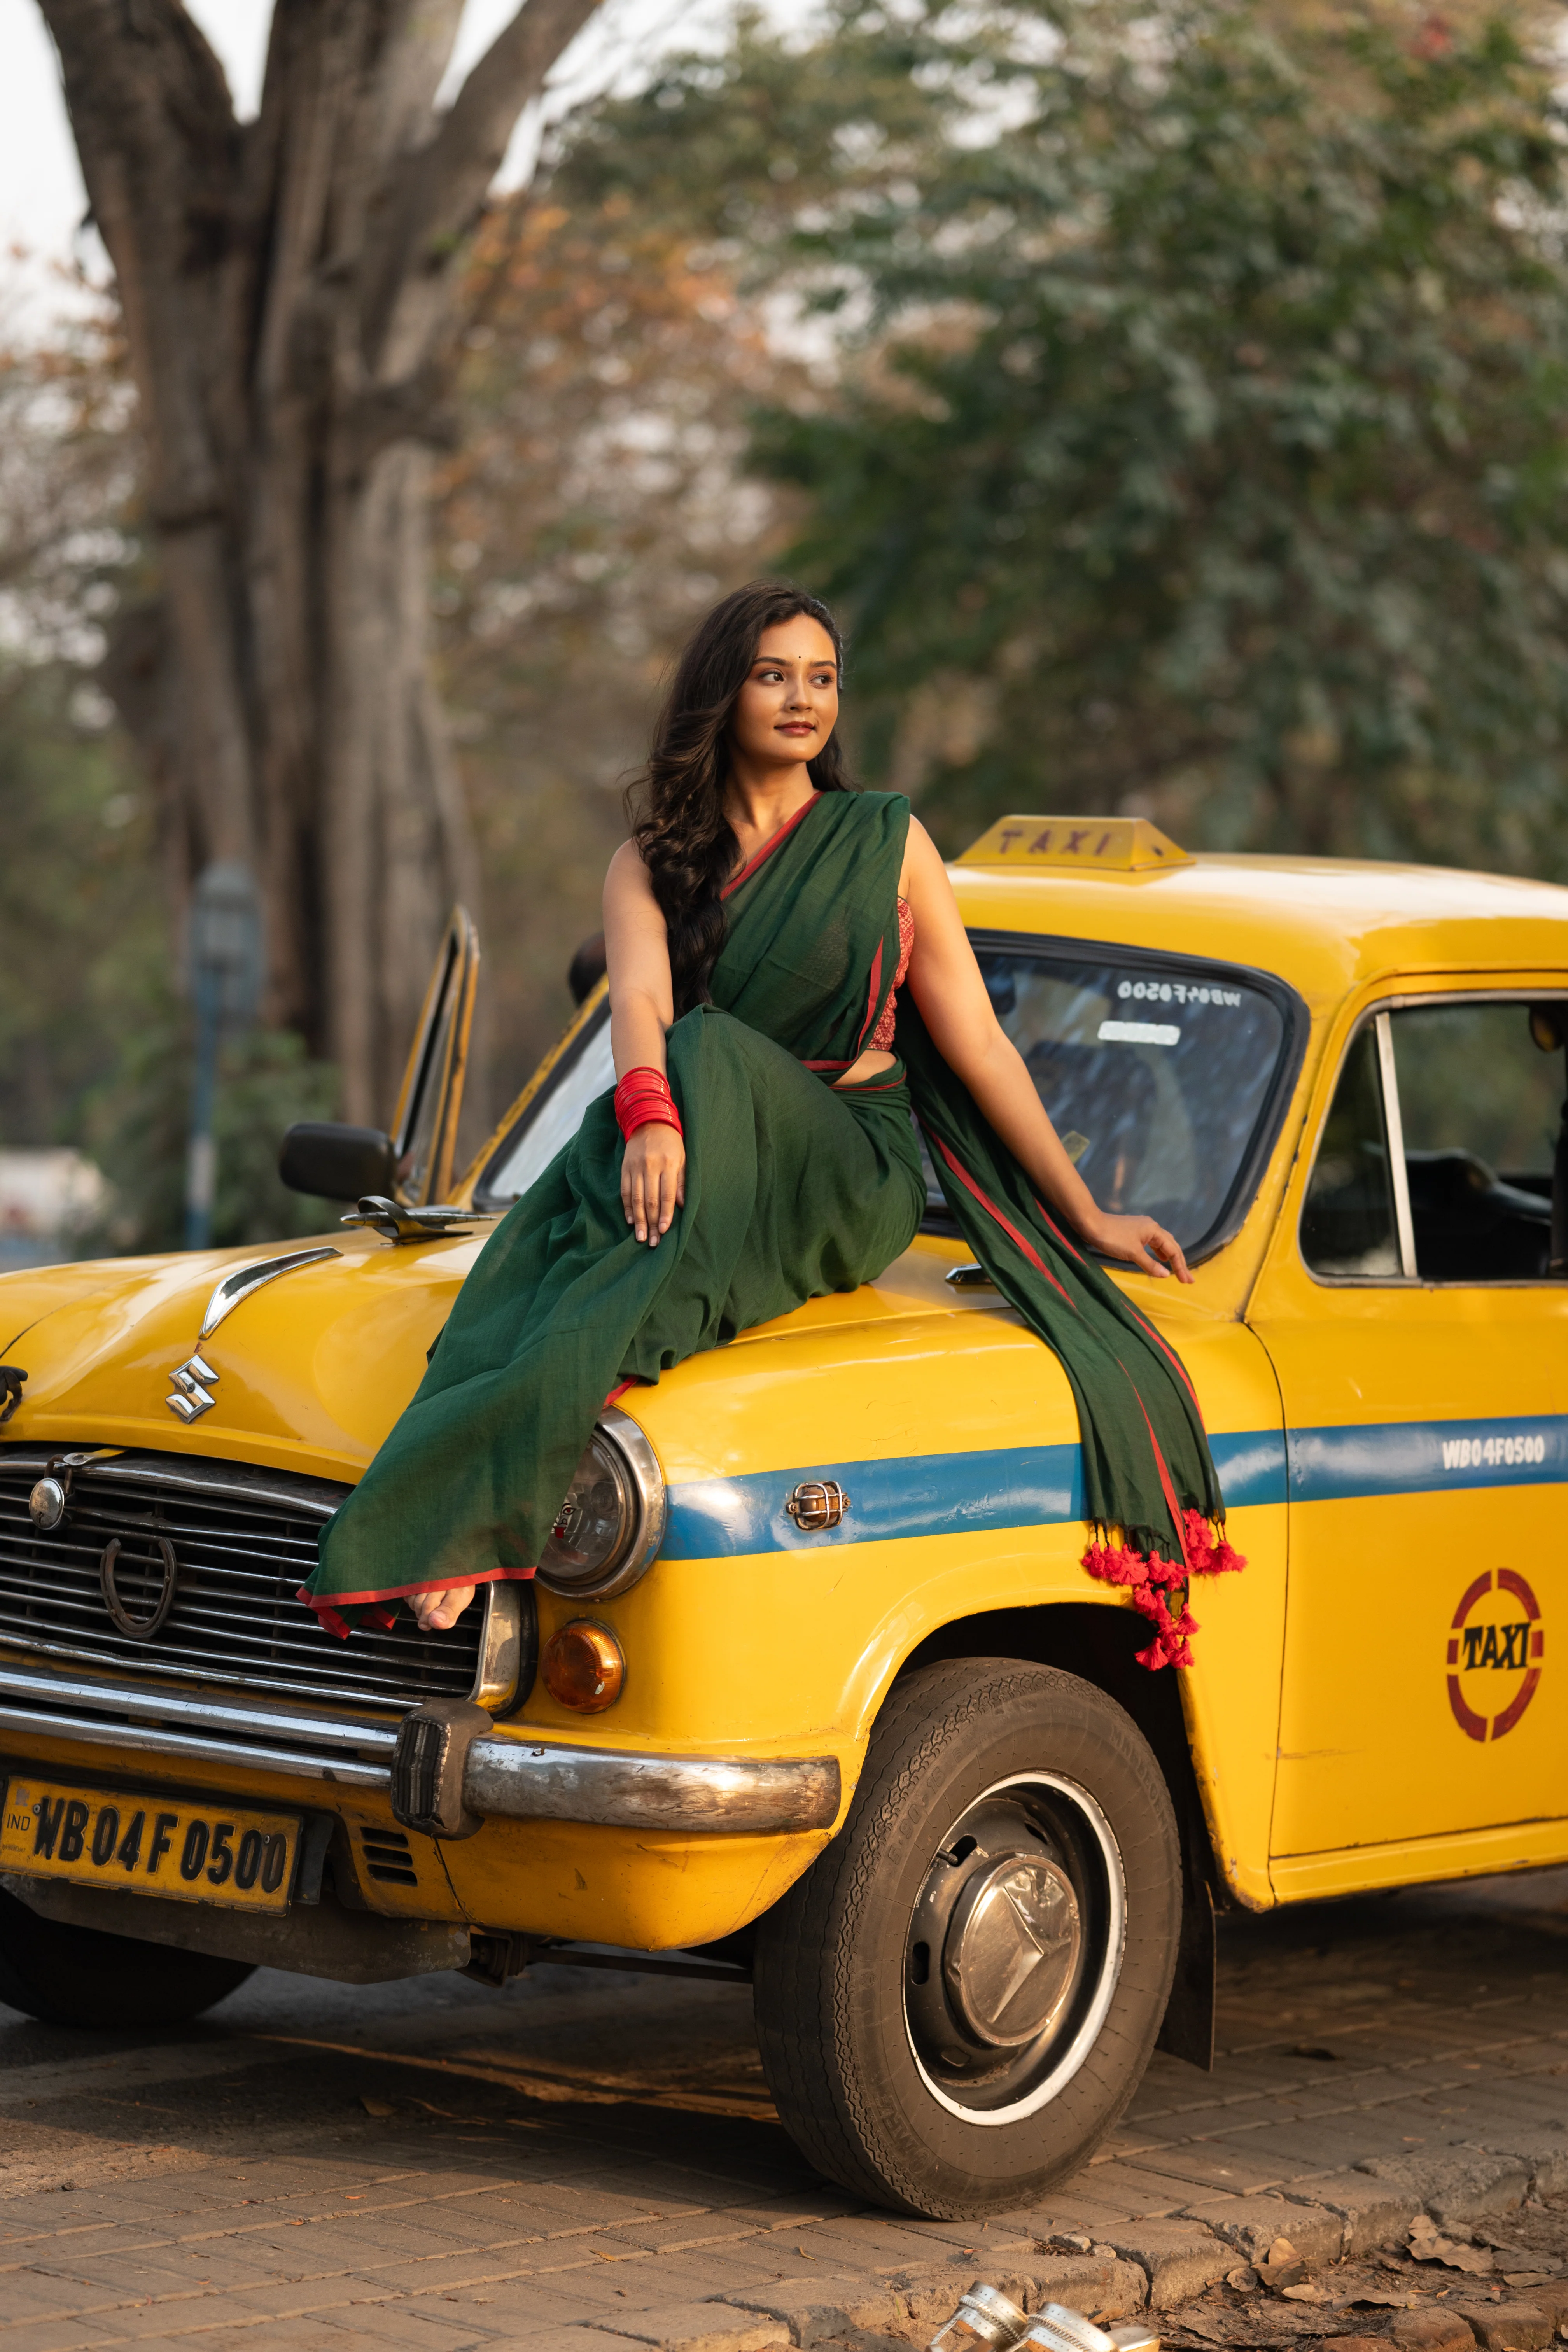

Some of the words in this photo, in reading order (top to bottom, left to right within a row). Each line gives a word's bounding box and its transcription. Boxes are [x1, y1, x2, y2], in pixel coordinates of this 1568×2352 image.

[999, 830, 1111, 855] TAXI
[1462, 1622, 1531, 1670] TAXI
[6, 1813, 31, 1831] IND
